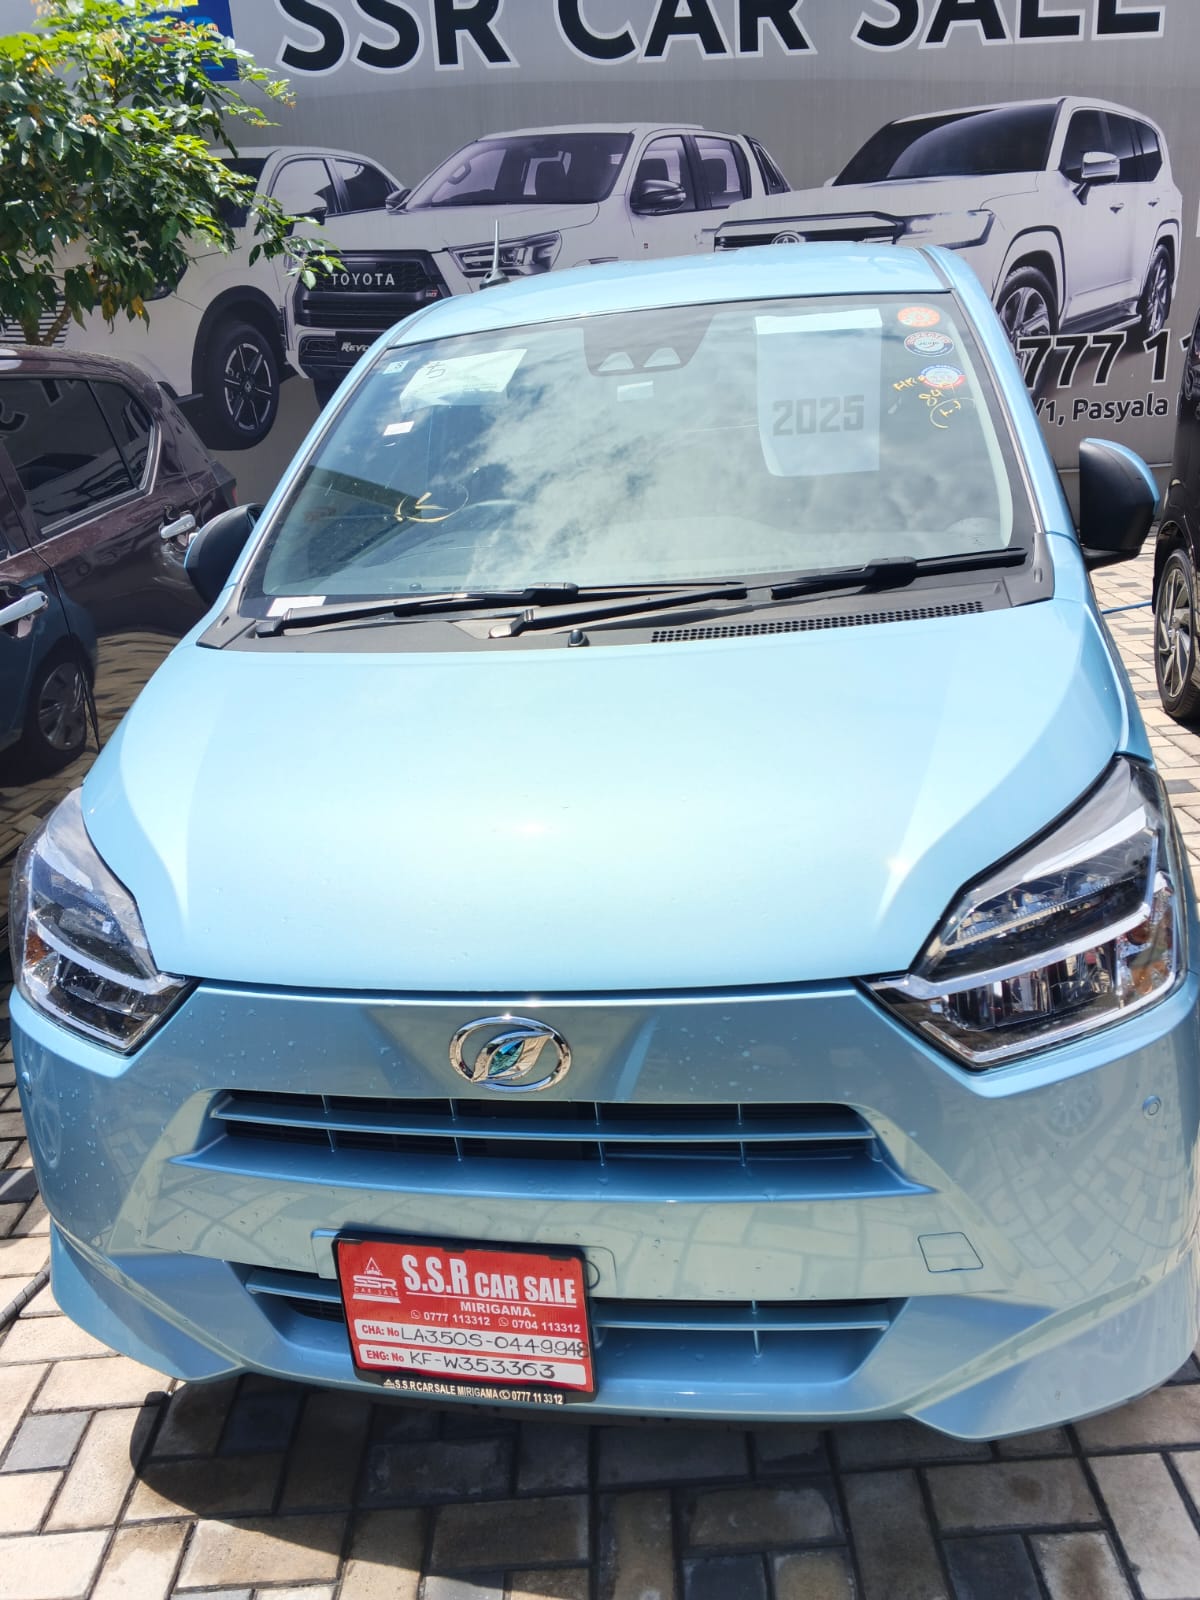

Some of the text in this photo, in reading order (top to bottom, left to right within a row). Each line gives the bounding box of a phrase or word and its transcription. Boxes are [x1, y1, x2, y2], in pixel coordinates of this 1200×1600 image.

[276, 0, 519, 76] SSR
[554, 0, 818, 65] CAR
[331, 273, 396, 286] TOYOTA
[1143, 328, 1191, 384] 1
[773, 394, 865, 436] 2025
[1072, 392, 1169, 423] Pasyala
[353, 1275, 398, 1290] SSR
[401, 1254, 577, 1304] S.S.R CAR SALE
[423, 1311, 581, 1334] 0777 113312 0704 113312
[460, 1301, 536, 1317] MIRIGAMA.
[361, 1324, 589, 1358] CHA: No LA350S-0449948
[366, 1349, 555, 1380] ENG: No KF-W353363
[434, 1384, 456, 1395] SALE
[457, 1385, 499, 1399] MIRIGAMA
[511, 1391, 531, 1402] 0777
